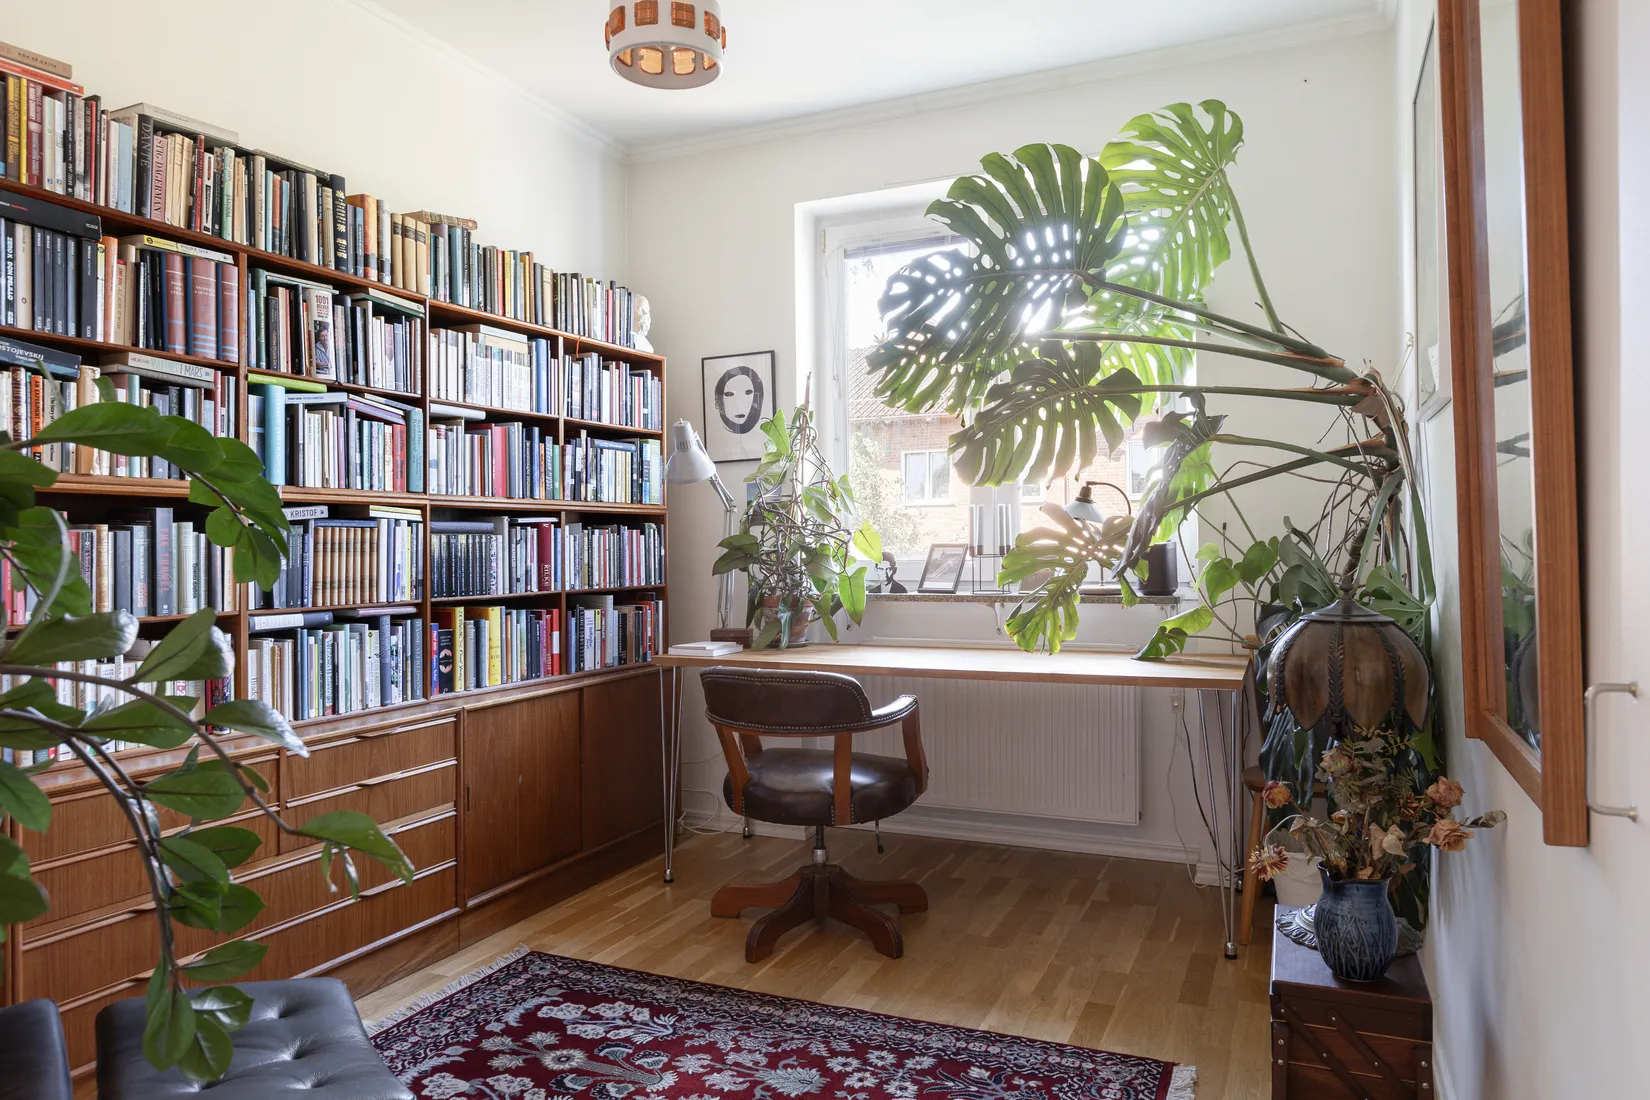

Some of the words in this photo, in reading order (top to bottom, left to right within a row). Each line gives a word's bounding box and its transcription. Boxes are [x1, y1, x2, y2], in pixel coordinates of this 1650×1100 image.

[141, 122, 151, 168] DANTE
[156, 140, 164, 160] STIG
[154, 161, 163, 212] DAGERMAN
[315, 295, 329, 305] 1001
[184, 364, 203, 378] MARS
[35, 380, 40, 389] AN
[290, 509, 318, 518] KRISTOF
[160, 527, 169, 547] THE
[160, 552, 169, 593] TUNNEL
